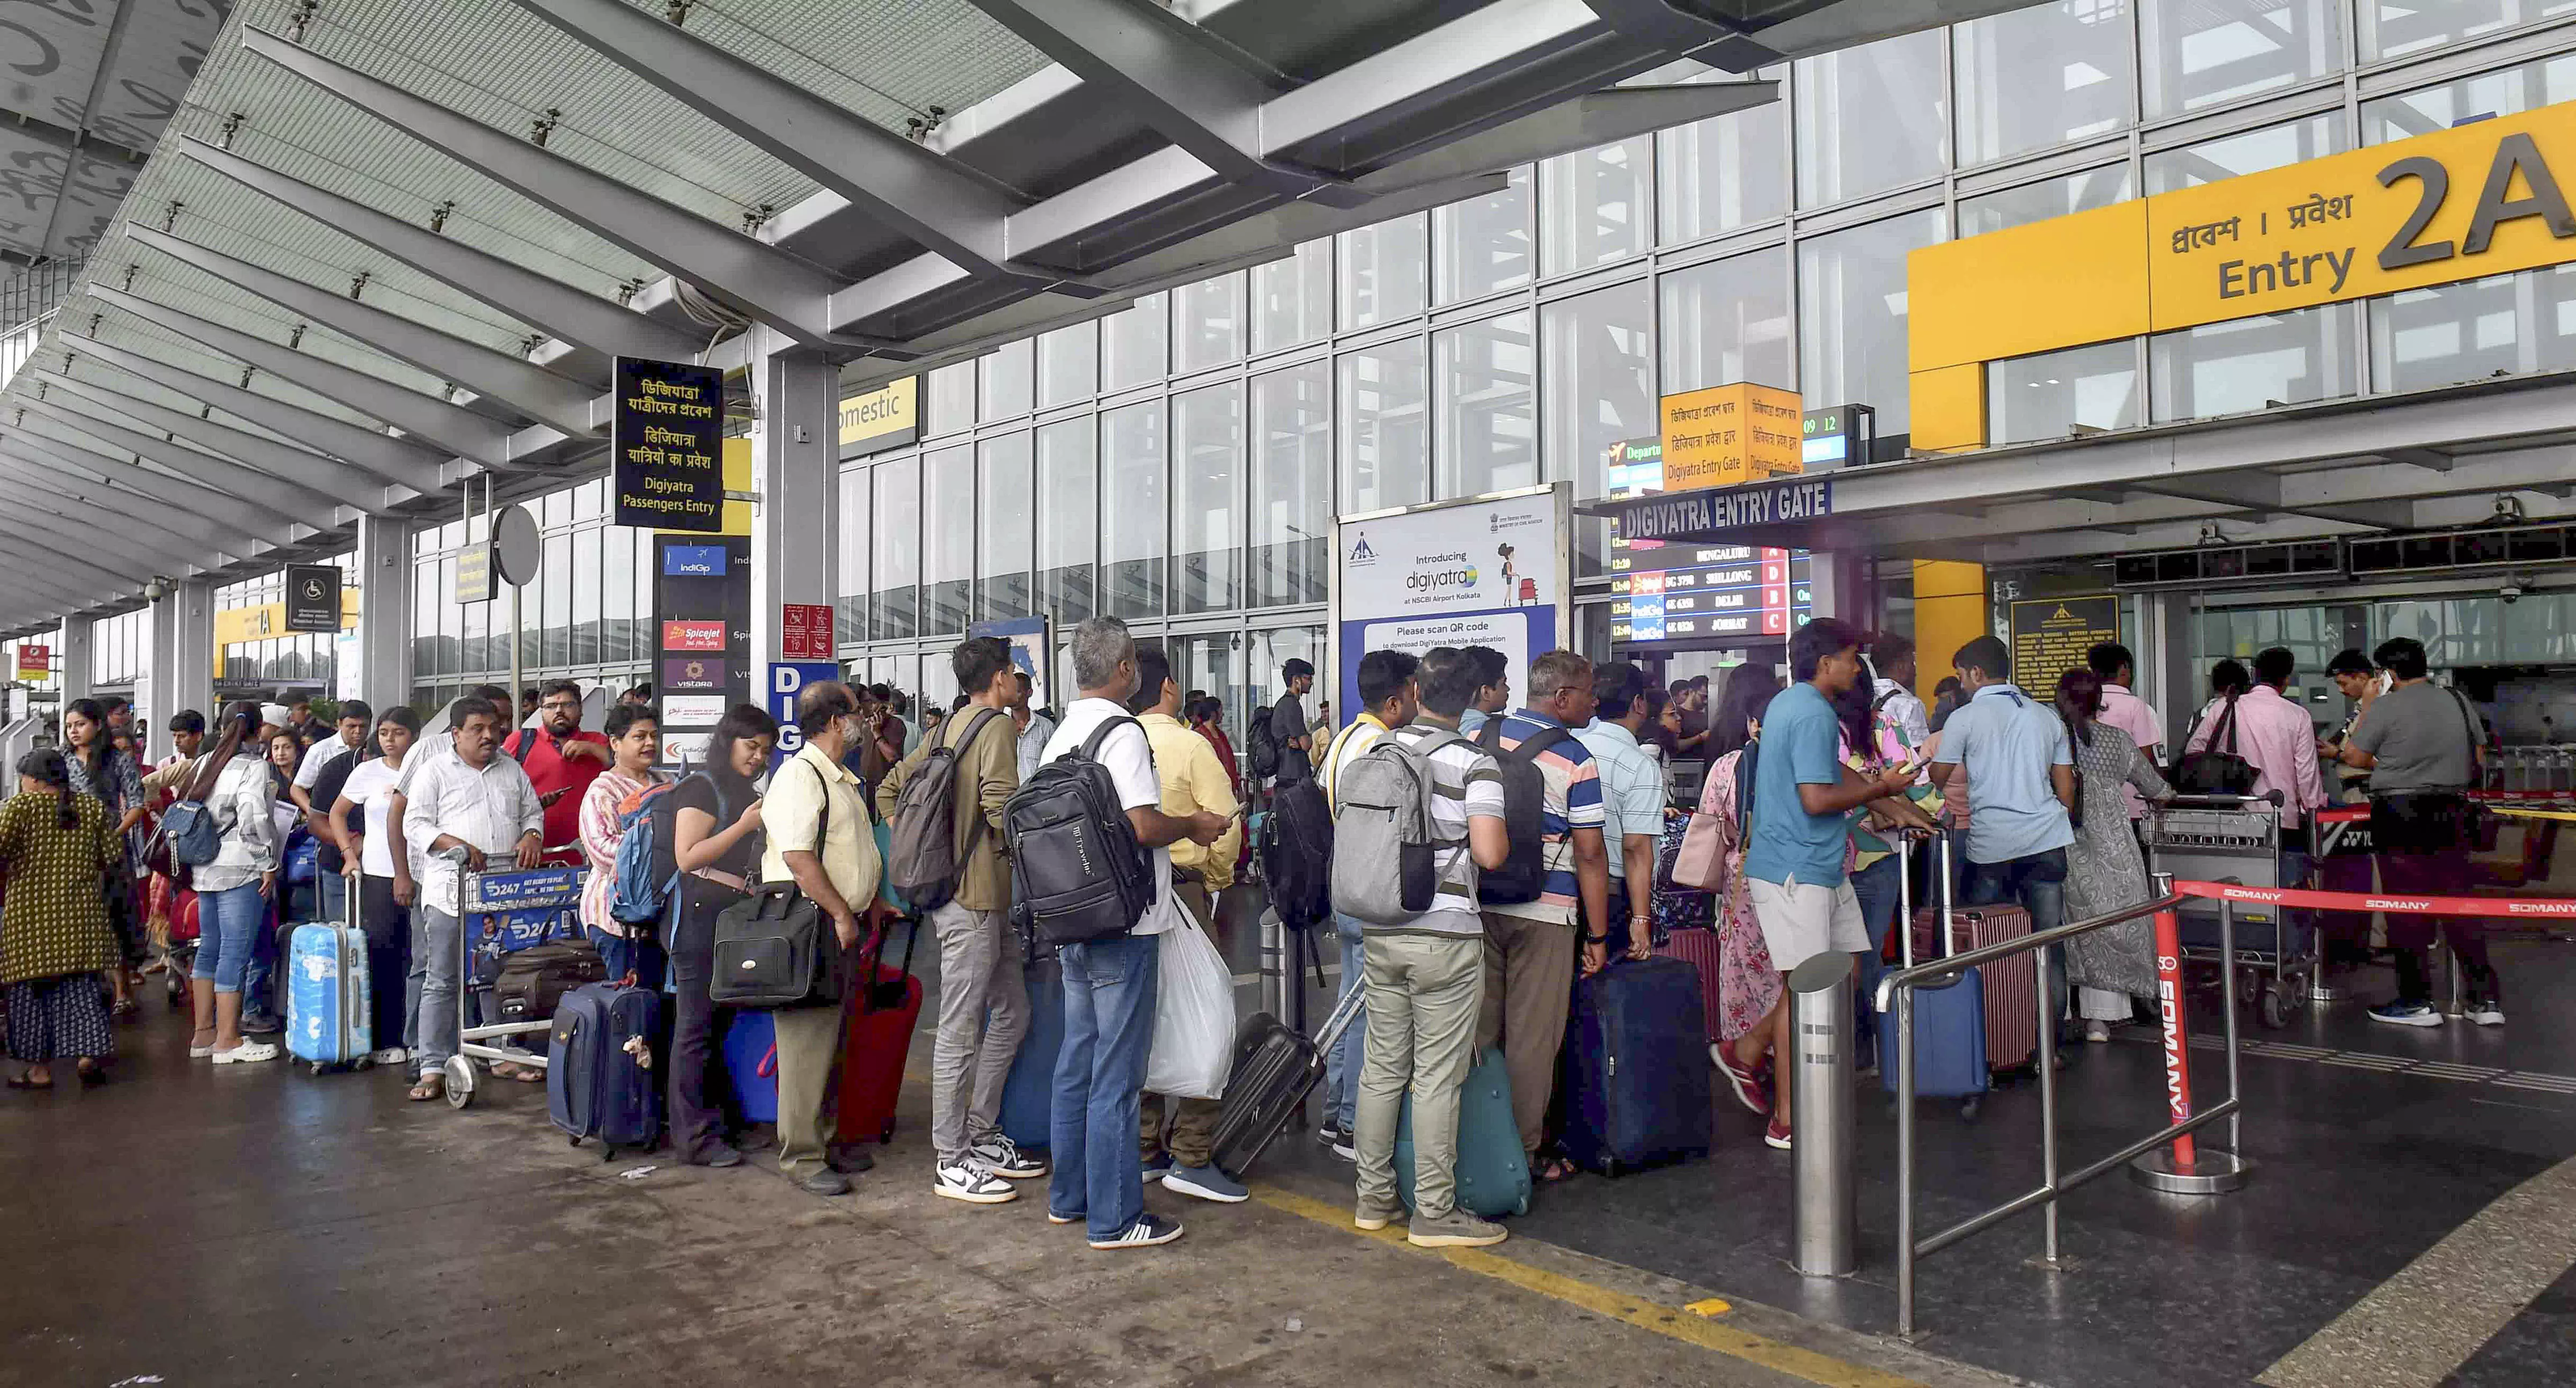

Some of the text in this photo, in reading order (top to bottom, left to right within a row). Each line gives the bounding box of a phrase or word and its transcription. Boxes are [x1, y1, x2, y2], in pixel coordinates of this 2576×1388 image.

[2287, 194, 2354, 230] प्रवेश
[2375, 132, 2576, 272] 2A
[2171, 215, 2241, 255] প্রবেশ
[2219, 247, 2356, 299] Entry
[680, 402, 712, 418] প্রবেশ
[1804, 416, 1836, 434] 09 12
[644, 426, 696, 447] डिजियात्रा
[1672, 434, 1702, 452] डिजियात्रा
[1706, 429, 1721, 446] प्रवेश
[627, 446, 711, 469] यात्रियों का प्रवेश
[1668, 463, 1701, 481] Digiyatra
[1702, 459, 1722, 476] Entry
[1723, 457, 1740, 471] Gate
[645, 476, 694, 494] Digiyatra
[623, 494, 715, 516] Passengers Entry
[1626, 482, 1825, 538] DIGIYATRA ENTRY GATE
[1416, 552, 1467, 565] Introducing
[1406, 567, 1468, 592] digiyatra
[1769, 567, 1778, 580] D
[1433, 594, 1455, 603] Airport
[1769, 591, 1778, 604] B
[1397, 621, 1488, 636] Please scan QR code
[1769, 613, 1779, 628] C
[686, 628, 720, 640] SpiceJet
[1419, 639, 1446, 648] DigiYatra
[1470, 635, 1506, 644] Application
[2223, 888, 2576, 913] SOMANY SOMANY SOMANY
[2160, 980, 2183, 1115] SOMANY
